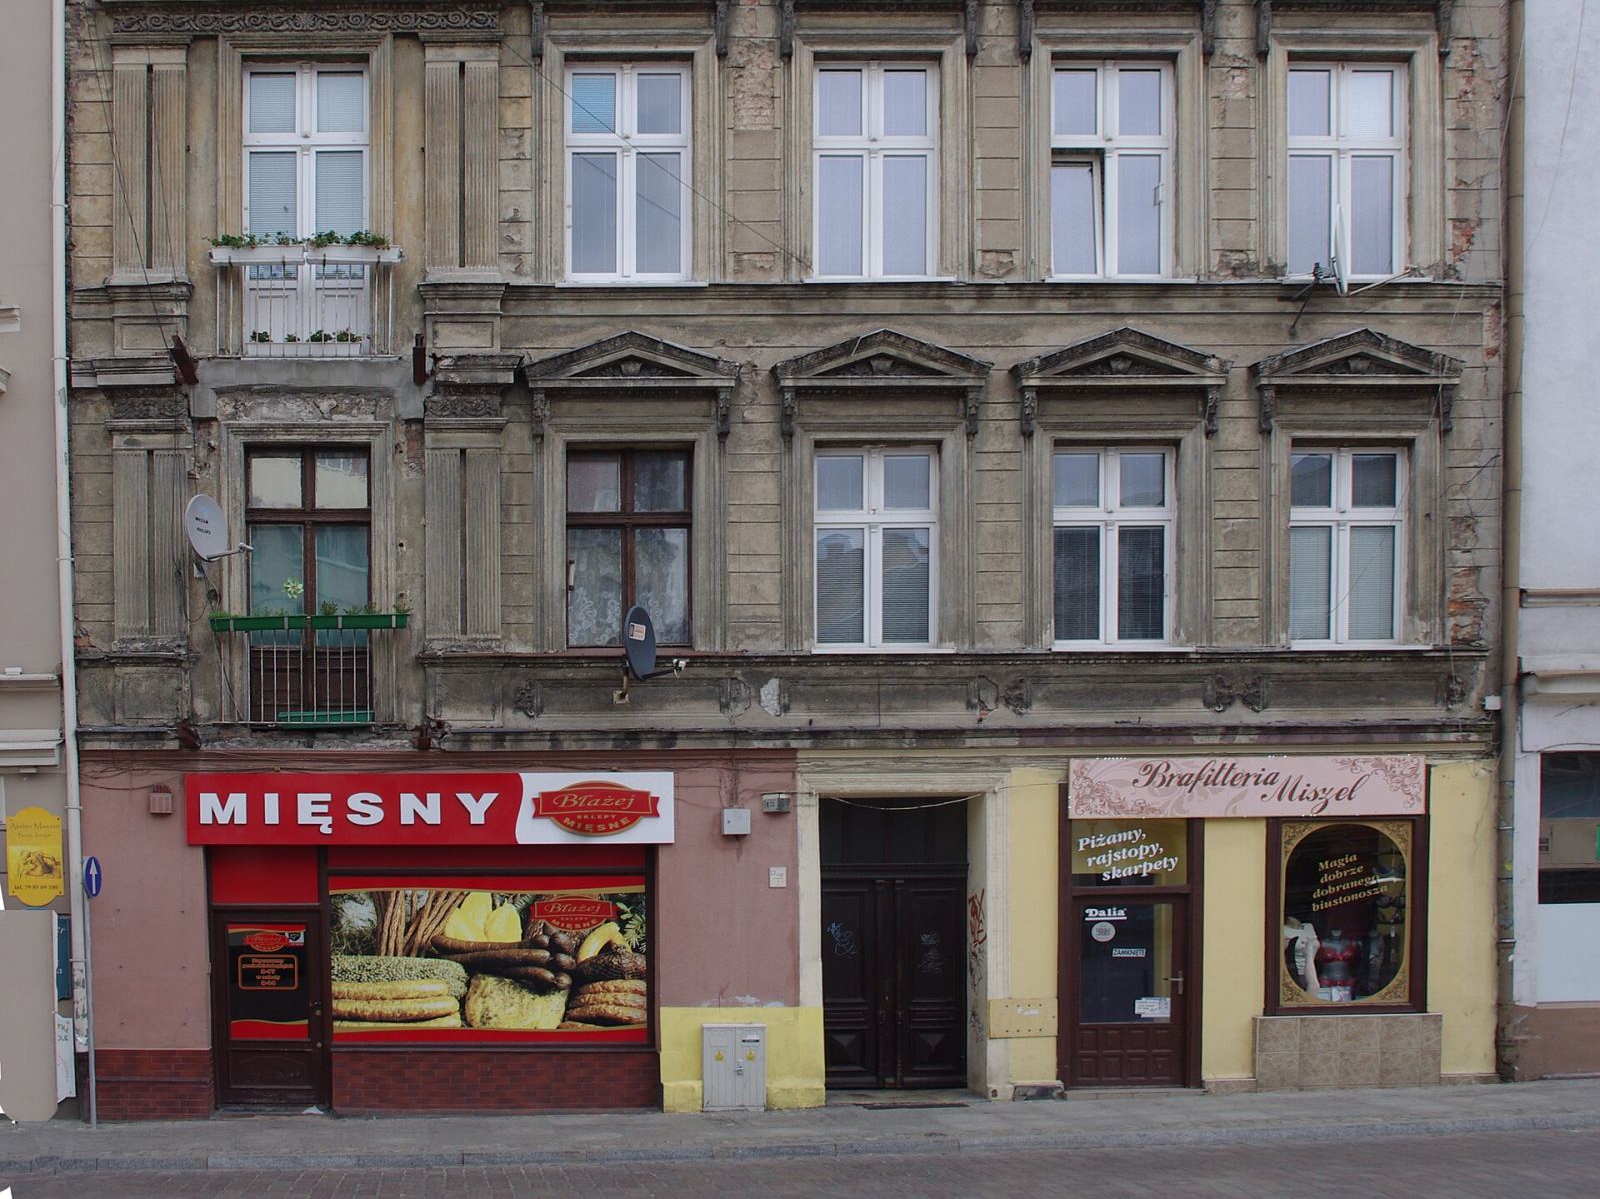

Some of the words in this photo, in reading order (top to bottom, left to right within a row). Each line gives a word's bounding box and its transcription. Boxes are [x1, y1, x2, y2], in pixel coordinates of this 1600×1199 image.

[1132, 759, 1281, 794] Brafitteria
[552, 793, 636, 809] Błażej
[1260, 773, 1370, 814] Miszel
[199, 792, 499, 834] MIĘSNY
[563, 816, 630, 833] MIĘSNE
[1078, 828, 1147, 851] Piżamy,
[1086, 843, 1164, 867] rajstopy,
[1318, 854, 1358, 872] Magia
[1102, 857, 1179, 882] skarpety
[1320, 865, 1364, 883] dobrze
[1311, 884, 1388, 912] biustonosza
[1312, 874, 1381, 899] dobranego
[543, 903, 602, 914] Błażej
